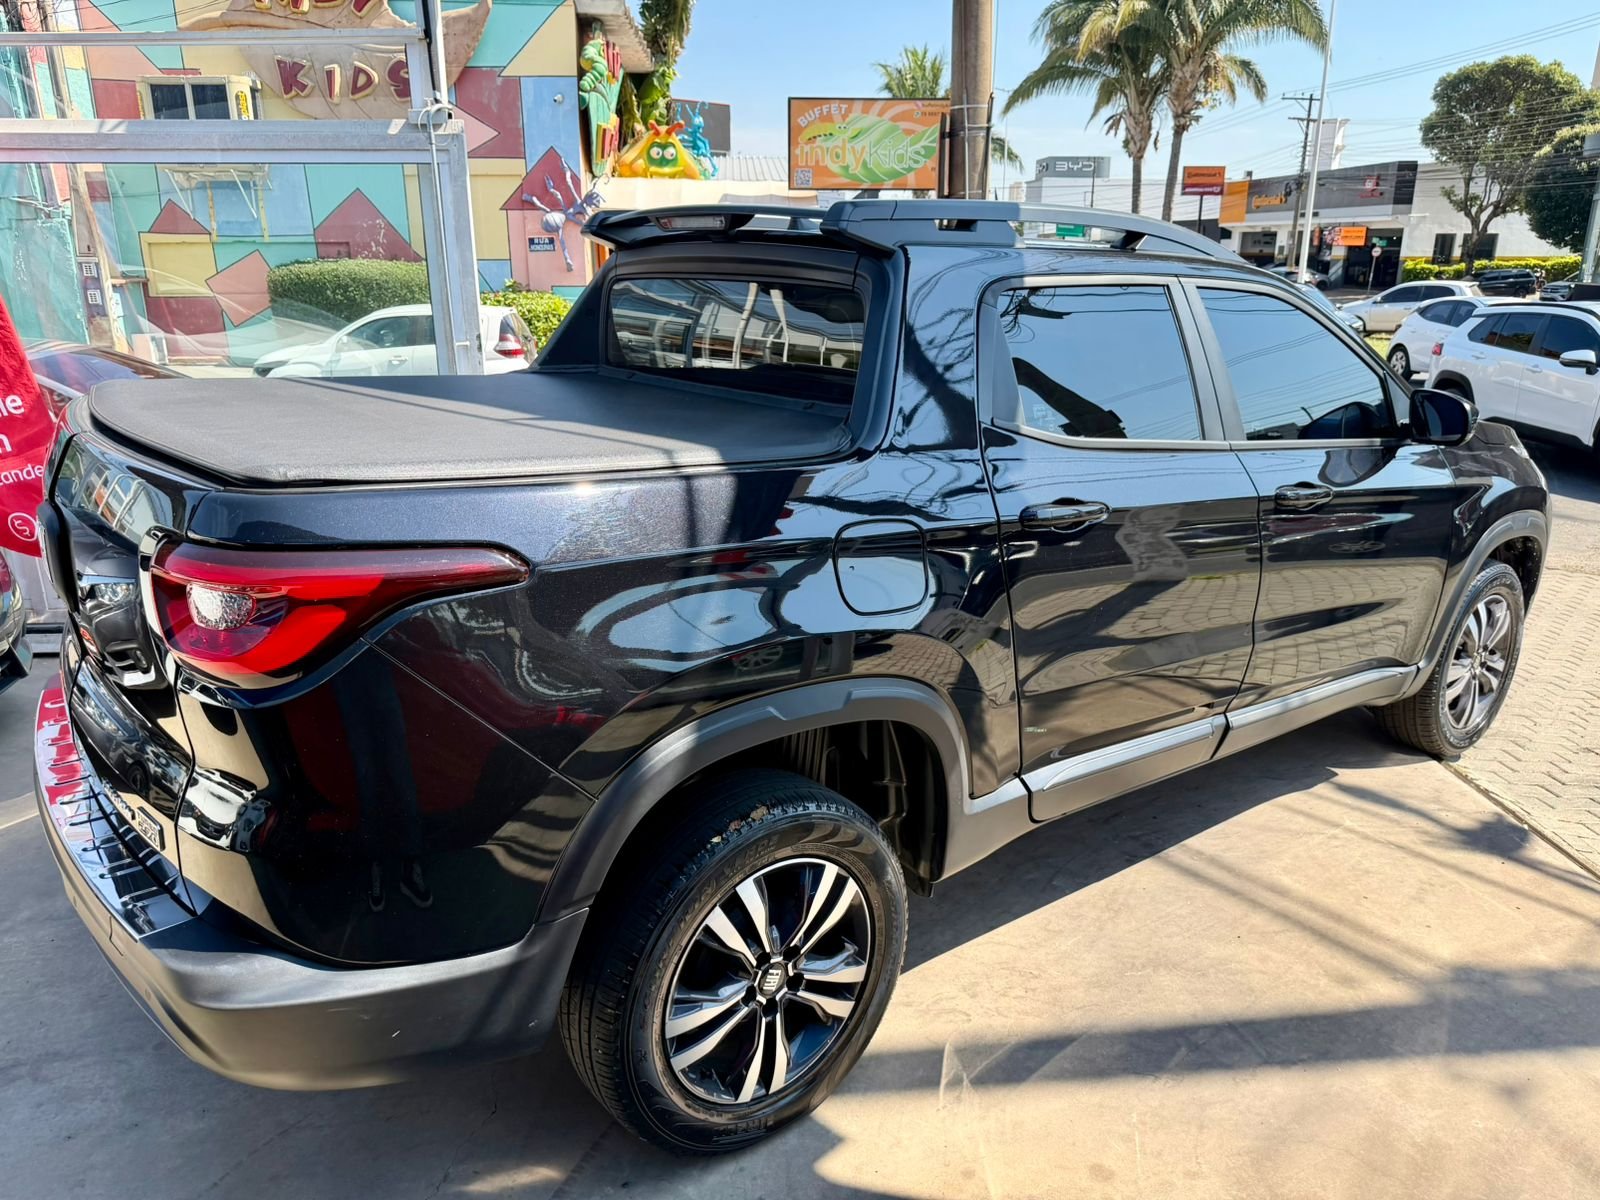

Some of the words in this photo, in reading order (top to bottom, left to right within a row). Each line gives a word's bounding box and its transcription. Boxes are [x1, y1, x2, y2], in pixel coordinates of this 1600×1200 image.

[275, 55, 411, 104] KIDS
[798, 103, 848, 128] BUFFET
[1055, 161, 1094, 171] BYD
[763, 969, 781, 991] FIAT
